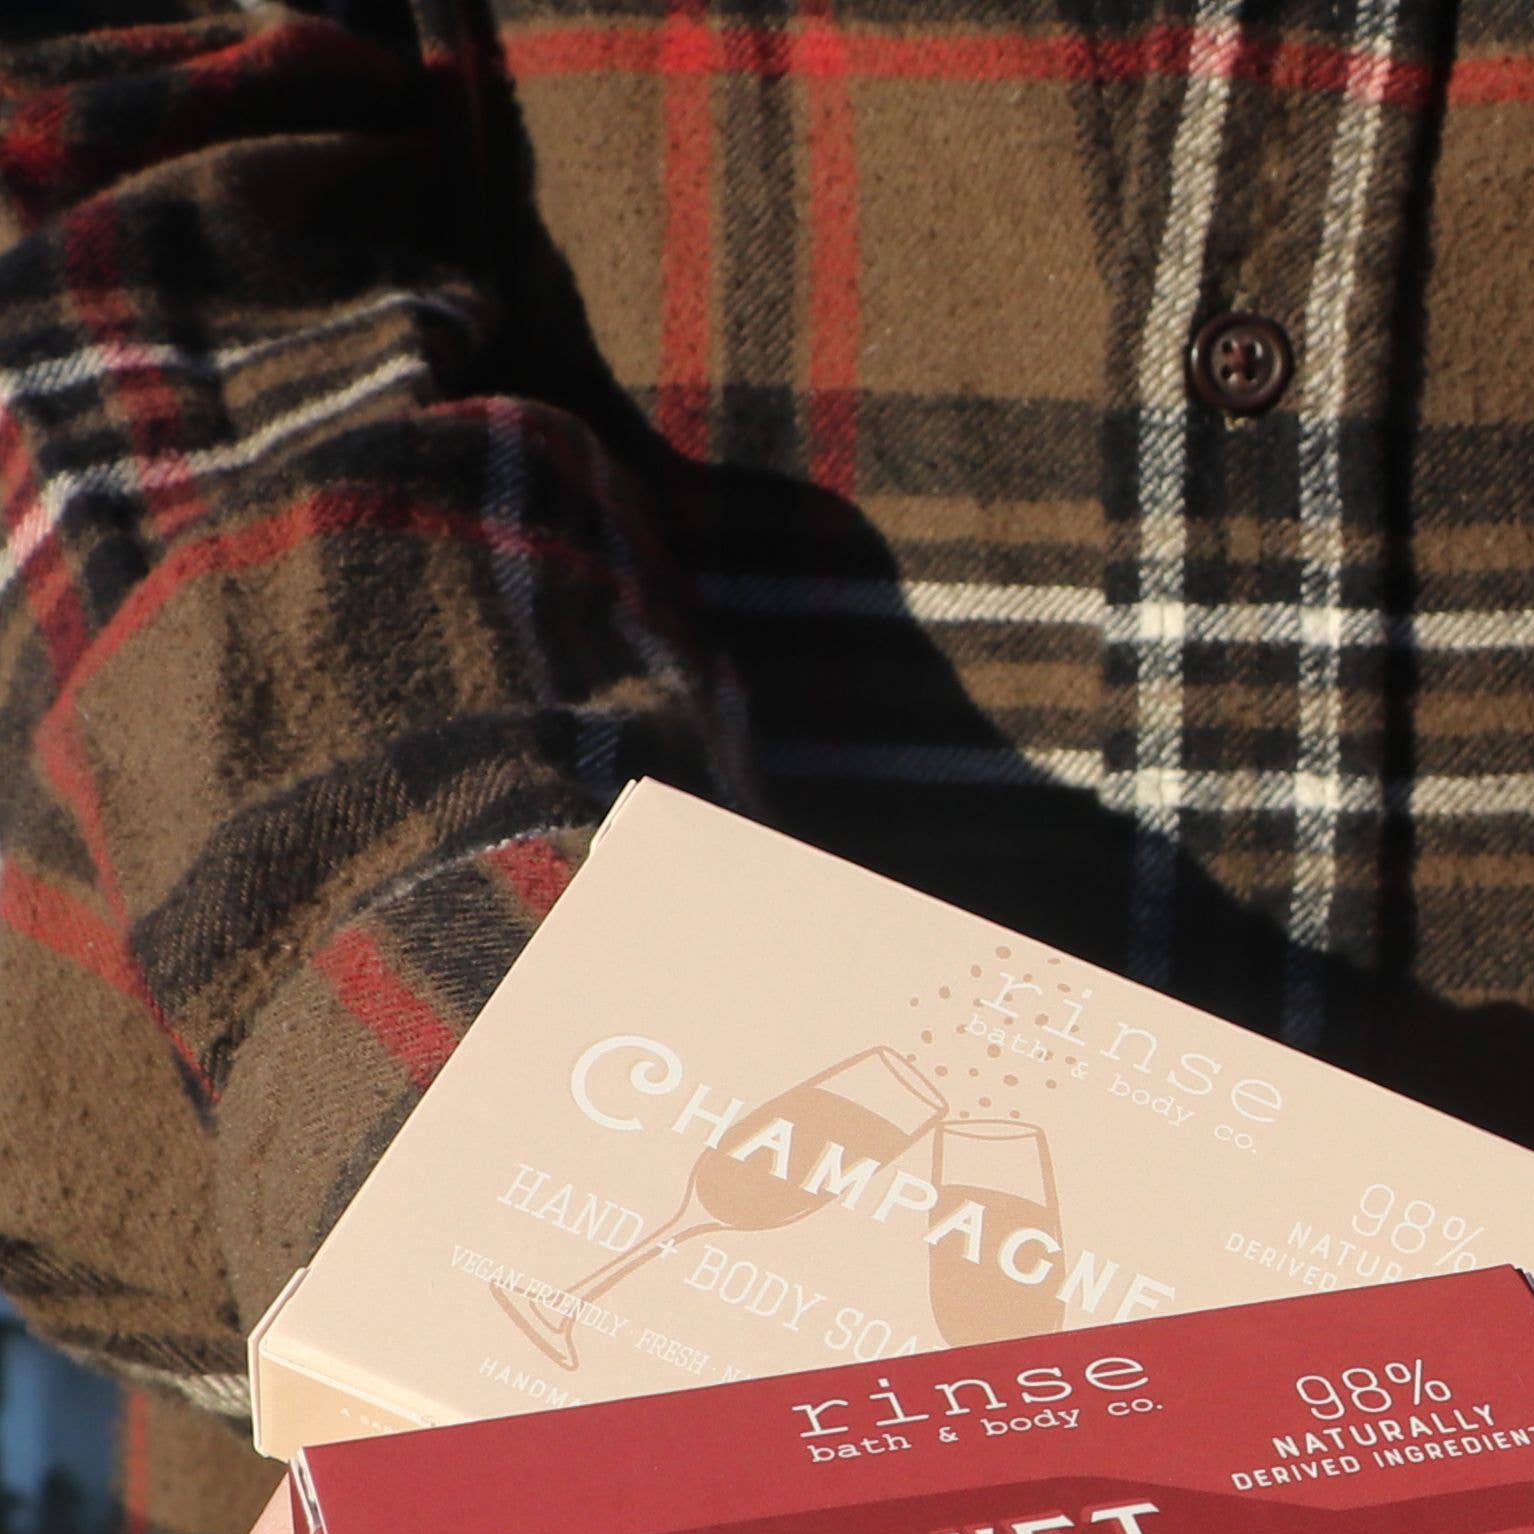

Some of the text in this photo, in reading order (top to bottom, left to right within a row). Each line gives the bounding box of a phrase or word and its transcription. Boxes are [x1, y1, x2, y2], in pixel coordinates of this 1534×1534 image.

[965, 1013, 1257, 1154] bath body co.
[980, 972, 1283, 1123] rinse
[497, 1163, 827, 1332] HAND BODY
[1224, 1232, 1337, 1291] DERIVED
[1352, 1183, 1485, 1273] 98%
[451, 1245, 711, 1377] VEGAN FRIENDLY FRESH
[792, 1357, 1148, 1437] rinse
[1296, 1359, 1451, 1420] 98%
[807, 1398, 1163, 1462] bath body co.
[1272, 1404, 1494, 1458] NATURALLY
[1231, 1456, 1360, 1490] DERIVED
